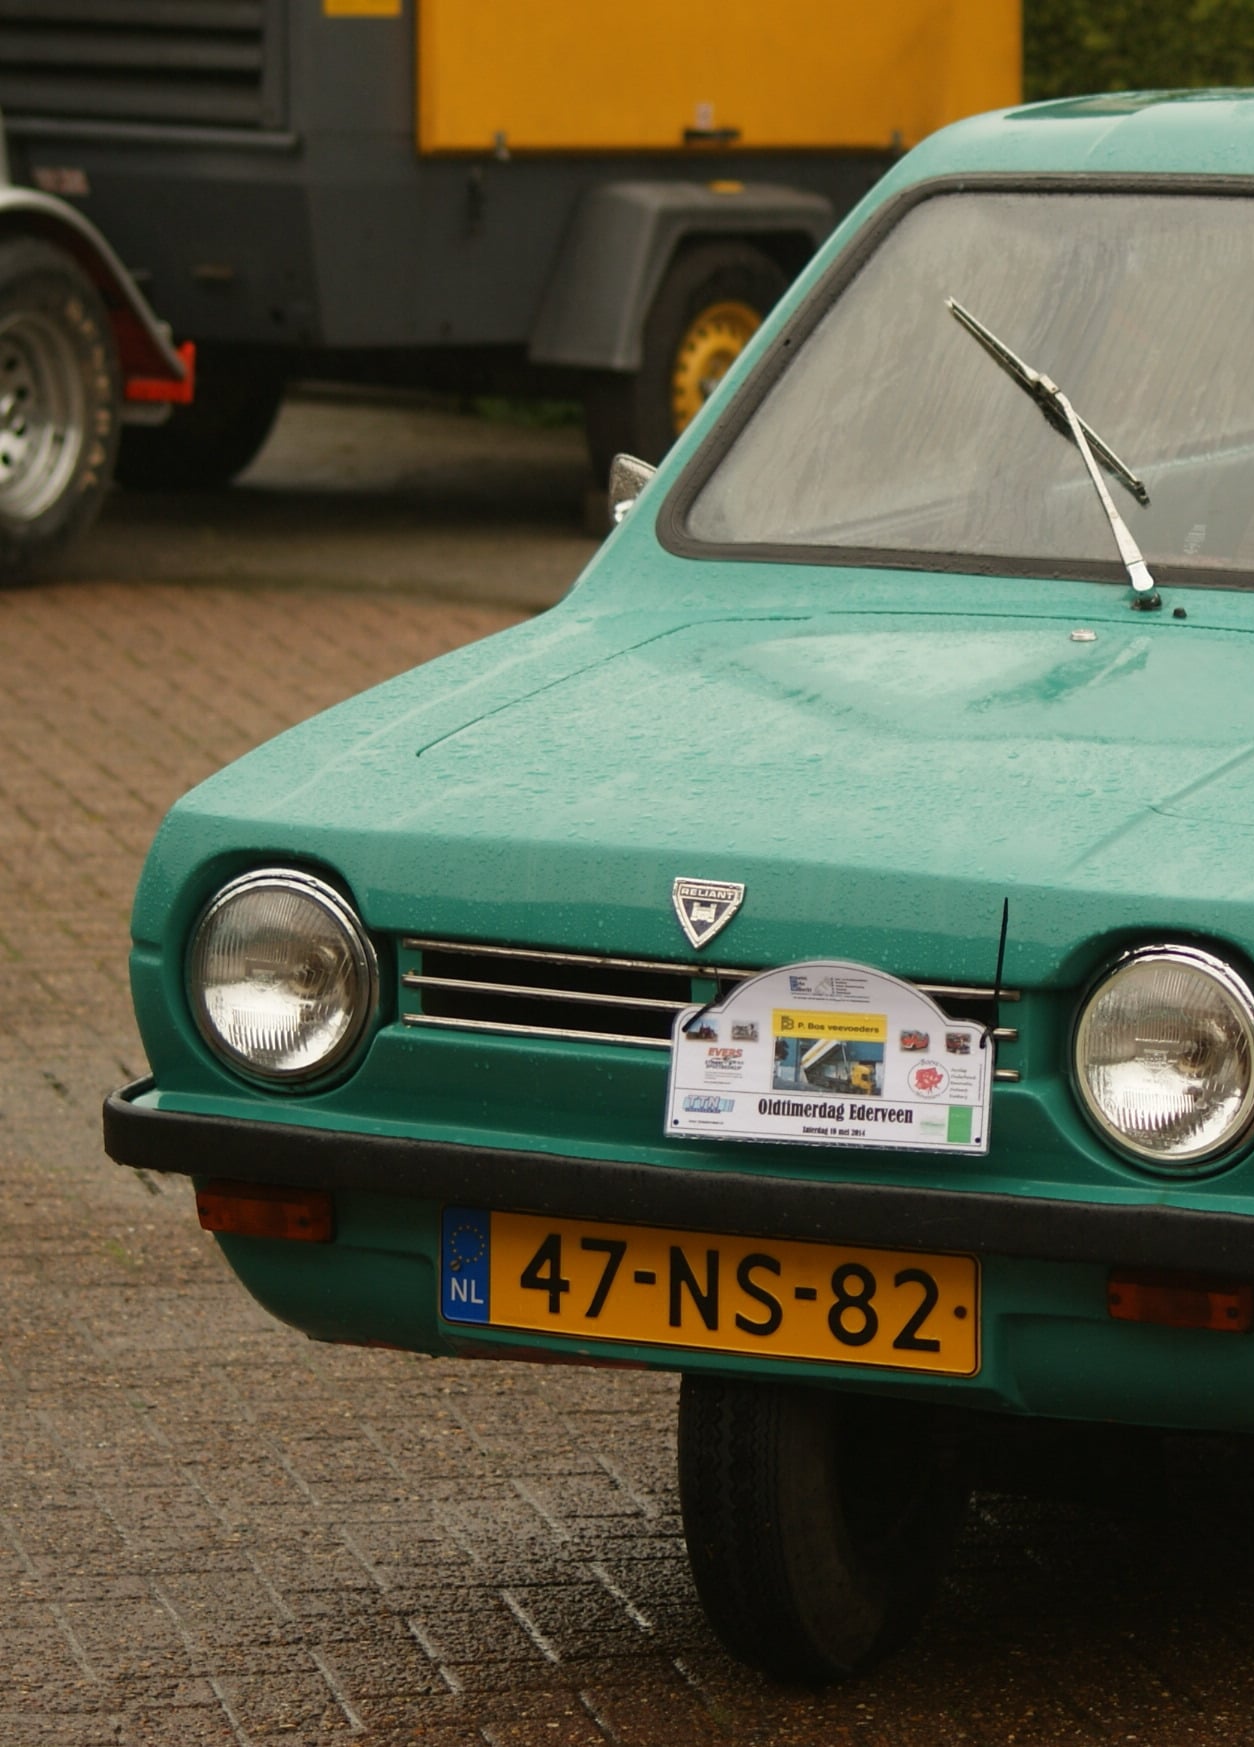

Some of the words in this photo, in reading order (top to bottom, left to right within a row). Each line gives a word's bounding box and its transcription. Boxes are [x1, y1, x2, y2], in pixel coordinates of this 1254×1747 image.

[681, 887, 735, 899] RELIANT
[807, 1022, 825, 1030] Bos
[827, 1025, 880, 1034] veevoeders
[708, 1047, 743, 1057] EVERS
[758, 1098, 845, 1122] Oldtimerdag
[849, 1103, 913, 1123] Ederveen
[838, 1128, 850, 1136] mei
[851, 1128, 866, 1137] 2014
[450, 1277, 485, 1305] NL
[519, 1232, 941, 1353] 47-NS-82
